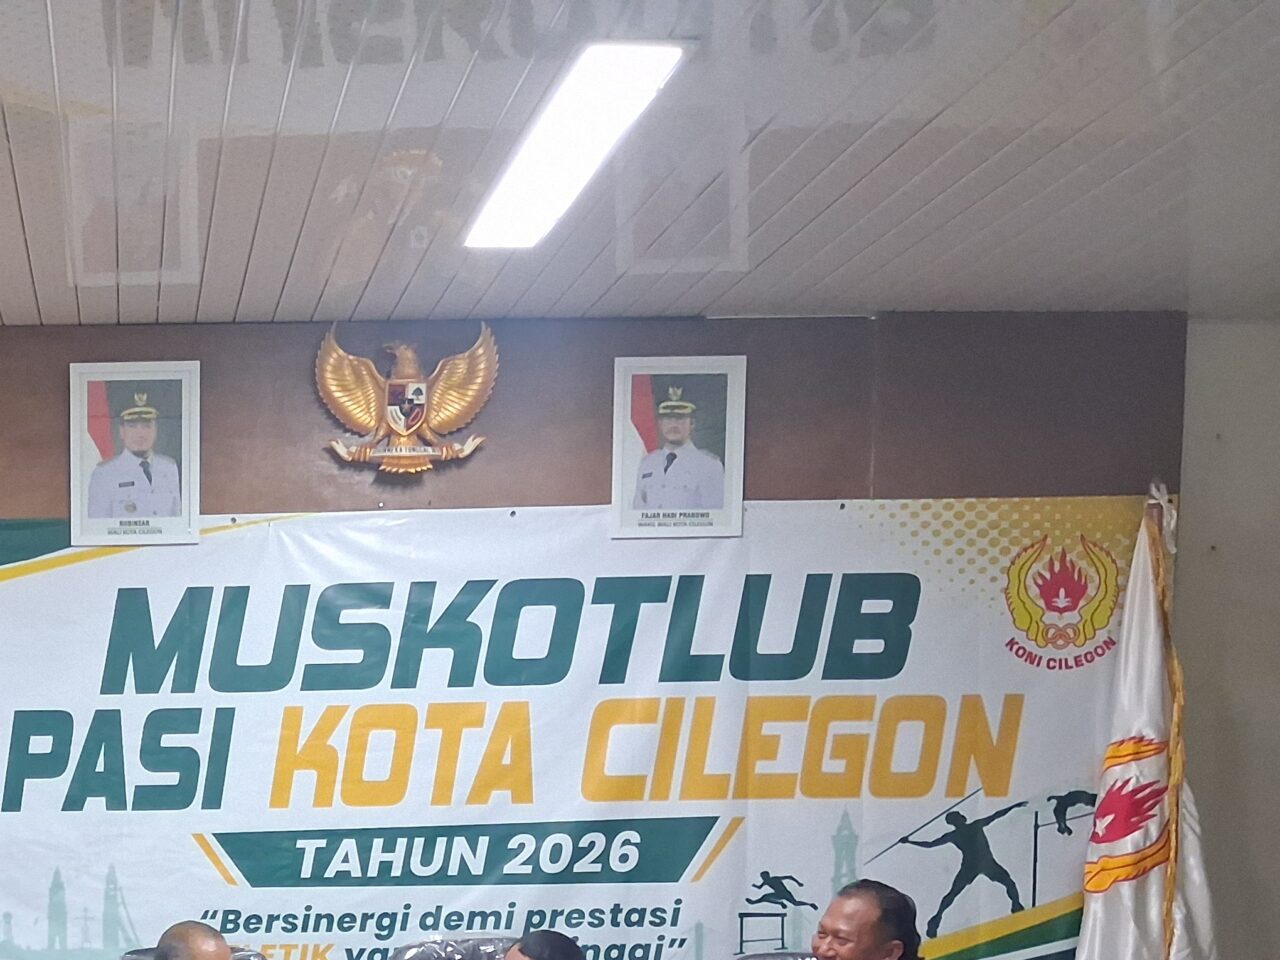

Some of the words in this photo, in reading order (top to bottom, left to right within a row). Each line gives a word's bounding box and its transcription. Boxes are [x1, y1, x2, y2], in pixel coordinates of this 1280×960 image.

[99, 572, 923, 695] MUSKOTLUB
[1005, 636, 1043, 668] KONI
[1046, 636, 1117, 670] CILEGON
[1, 707, 236, 813] PASI
[269, 703, 533, 808] KOTA
[580, 694, 1025, 803] CILEGON
[296, 836, 490, 879] TAHUN
[502, 831, 641, 874] 2026
[418, 902, 517, 932] demi
[521, 898, 684, 938] prestasi
